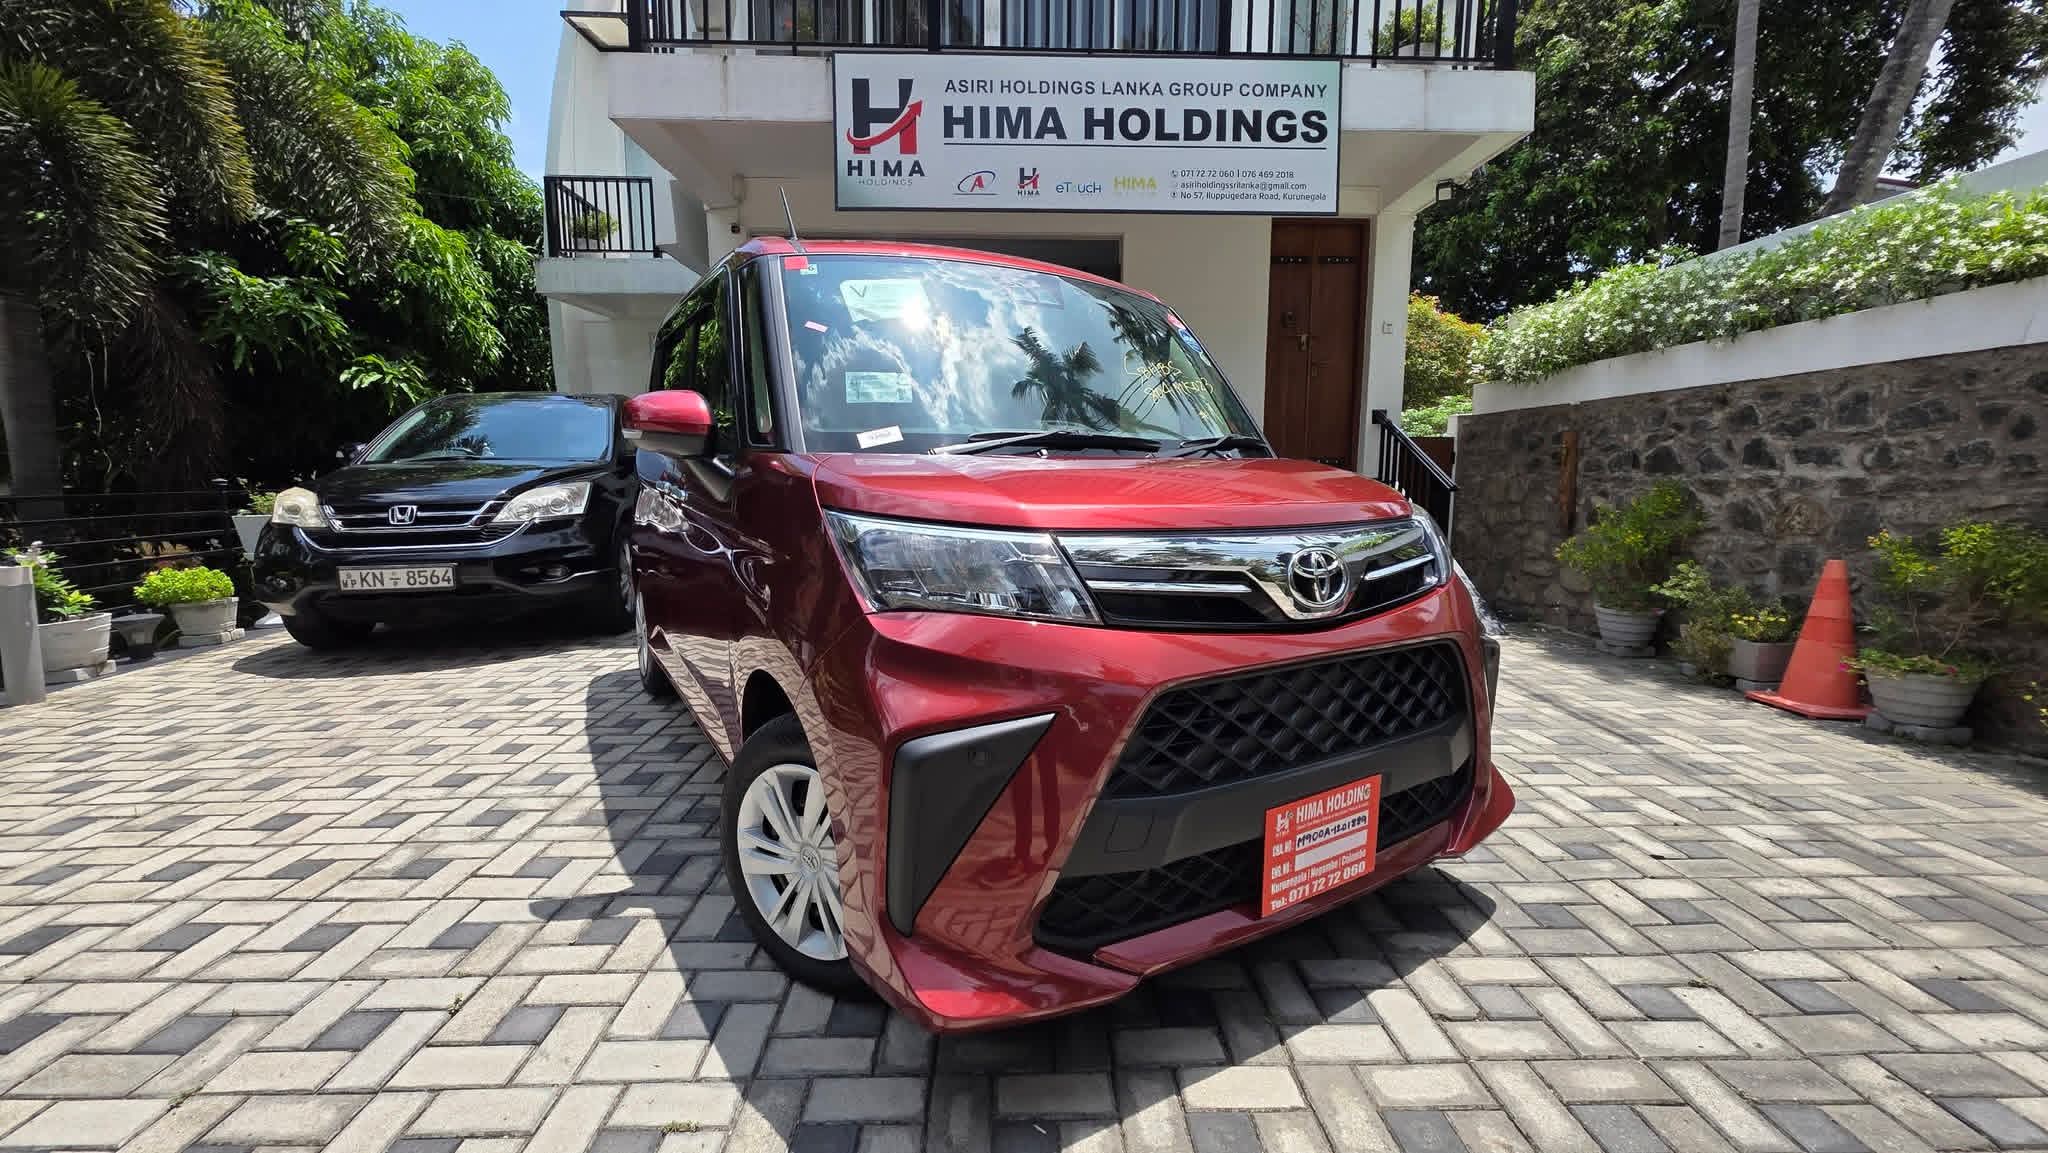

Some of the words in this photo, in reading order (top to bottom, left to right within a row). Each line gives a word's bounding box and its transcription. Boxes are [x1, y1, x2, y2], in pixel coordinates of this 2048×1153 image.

[945, 79, 993, 94] ASIRI
[1000, 80, 1095, 95] HOLDINGS
[1102, 81, 1163, 96] LANKA
[1169, 82, 1233, 97] GROUP
[1239, 83, 1327, 98] COMPANY
[943, 105, 1067, 140] HIMA
[1084, 107, 1328, 143] HOLDINGS
[847, 159, 925, 176] HIMA
[1180, 169, 1194, 178] 071
[1196, 169, 1206, 178] 72
[1207, 170, 1217, 178] 72
[1219, 170, 1235, 178] 060
[1241, 170, 1257, 178] 076
[1258, 170, 1274, 179] 469
[1275, 171, 1295, 179] 2018
[857, 178, 913, 186] HOLDINGS
[1113, 175, 1158, 192] HIMA
[1180, 181, 1307, 191] asiriholdingssrilanka@gmail.com
[1017, 189, 1041, 197] HIMA
[360, 571, 384, 587] KN
[406, 569, 452, 585] 8564
[1296, 800, 1323, 824] HIMA
[1327, 784, 1371, 813] HOLDING
[1289, 884, 1310, 902] 071
[1312, 877, 1326, 893] 72
[1327, 870, 1341, 887] 72
[1343, 860, 1366, 880] 060
